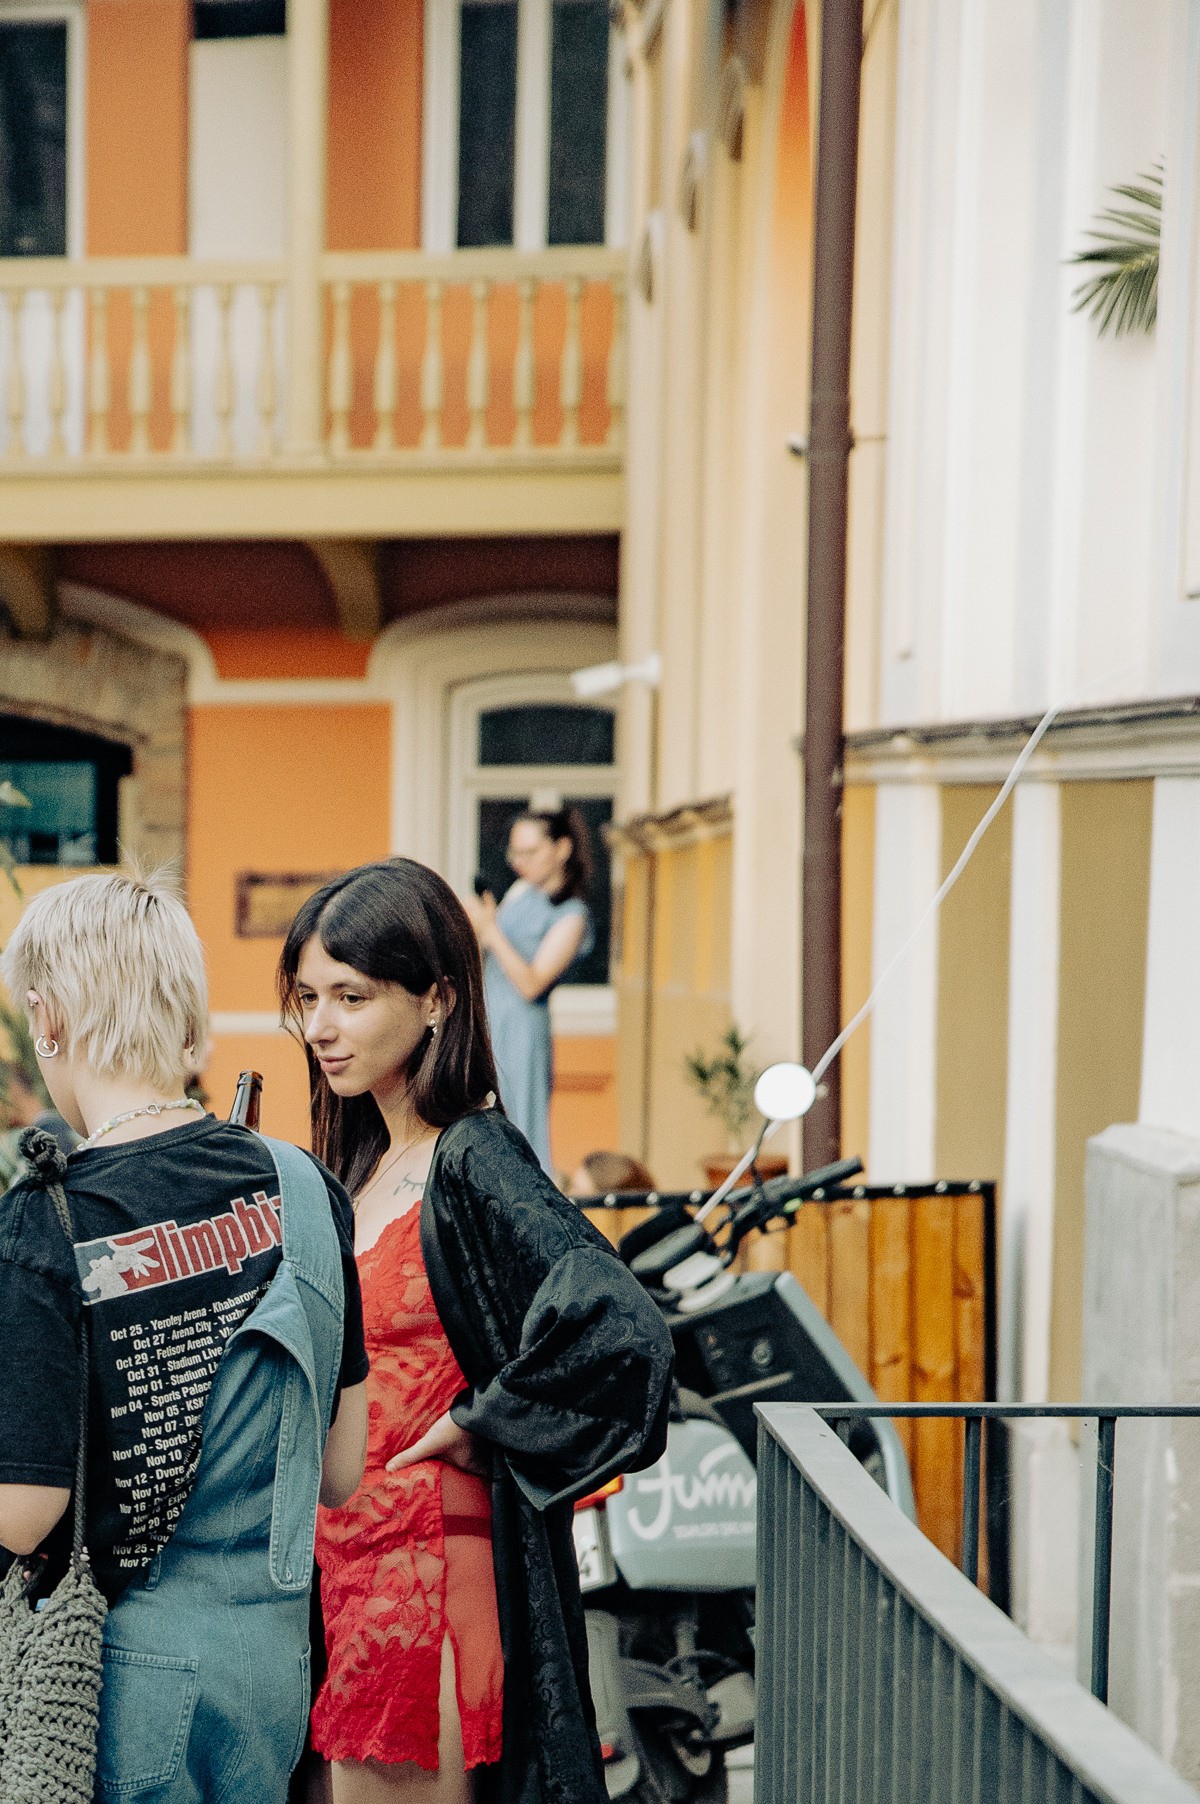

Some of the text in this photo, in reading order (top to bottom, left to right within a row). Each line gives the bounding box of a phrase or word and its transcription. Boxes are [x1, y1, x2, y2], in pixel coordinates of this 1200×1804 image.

[110, 1328, 127, 1342] Oct
[129, 1324, 143, 1337] 25
[184, 1307, 207, 1321] Arena
[212, 1287, 259, 1313] Khabarov
[133, 1337, 150, 1351] Oct
[152, 1333, 165, 1346] 27
[171, 1327, 194, 1341] Arena
[195, 1321, 212, 1334] City
[116, 1357, 133, 1370] Oct
[134, 1353, 148, 1365] 29
[156, 1342, 186, 1360] Fetisov
[187, 1336, 213, 1350] Arena
[127, 1369, 145, 1382] Oct
[147, 1365, 160, 1377] 31
[167, 1354, 202, 1371] Stadium
[201, 1346, 223, 1360] Live
[128, 1384, 148, 1397] Nov
[150, 1379, 163, 1391] 01
[170, 1367, 207, 1386] Stadium
[110, 1406, 127, 1418] Nov
[128, 1400, 142, 1412] 04
[150, 1391, 181, 1407] Sports
[181, 1381, 212, 1398] Palace
[144, 1410, 164, 1423] Nov
[166, 1404, 179, 1417] 05
[141, 1426, 162, 1438] Nov
[164, 1420, 177, 1433] 07
[112, 1449, 131, 1461] Nov
[133, 1443, 147, 1455] 09
[154, 1434, 187, 1451] Sports
[145, 1455, 166, 1467] Nov
[168, 1449, 182, 1462] 10
[115, 1478, 132, 1488] Nov
[134, 1472, 147, 1485] 12
[155, 1465, 185, 1480] Dvore
[131, 1488, 151, 1500] Nov
[153, 1482, 166, 1494] 14
[133, 1502, 146, 1513] 16
[128, 1524, 146, 1536] Nov
[148, 1517, 160, 1529] 20
[113, 1545, 132, 1555] Nov
[134, 1543, 147, 1554] 25
[119, 1557, 153, 1568] Nov 2
